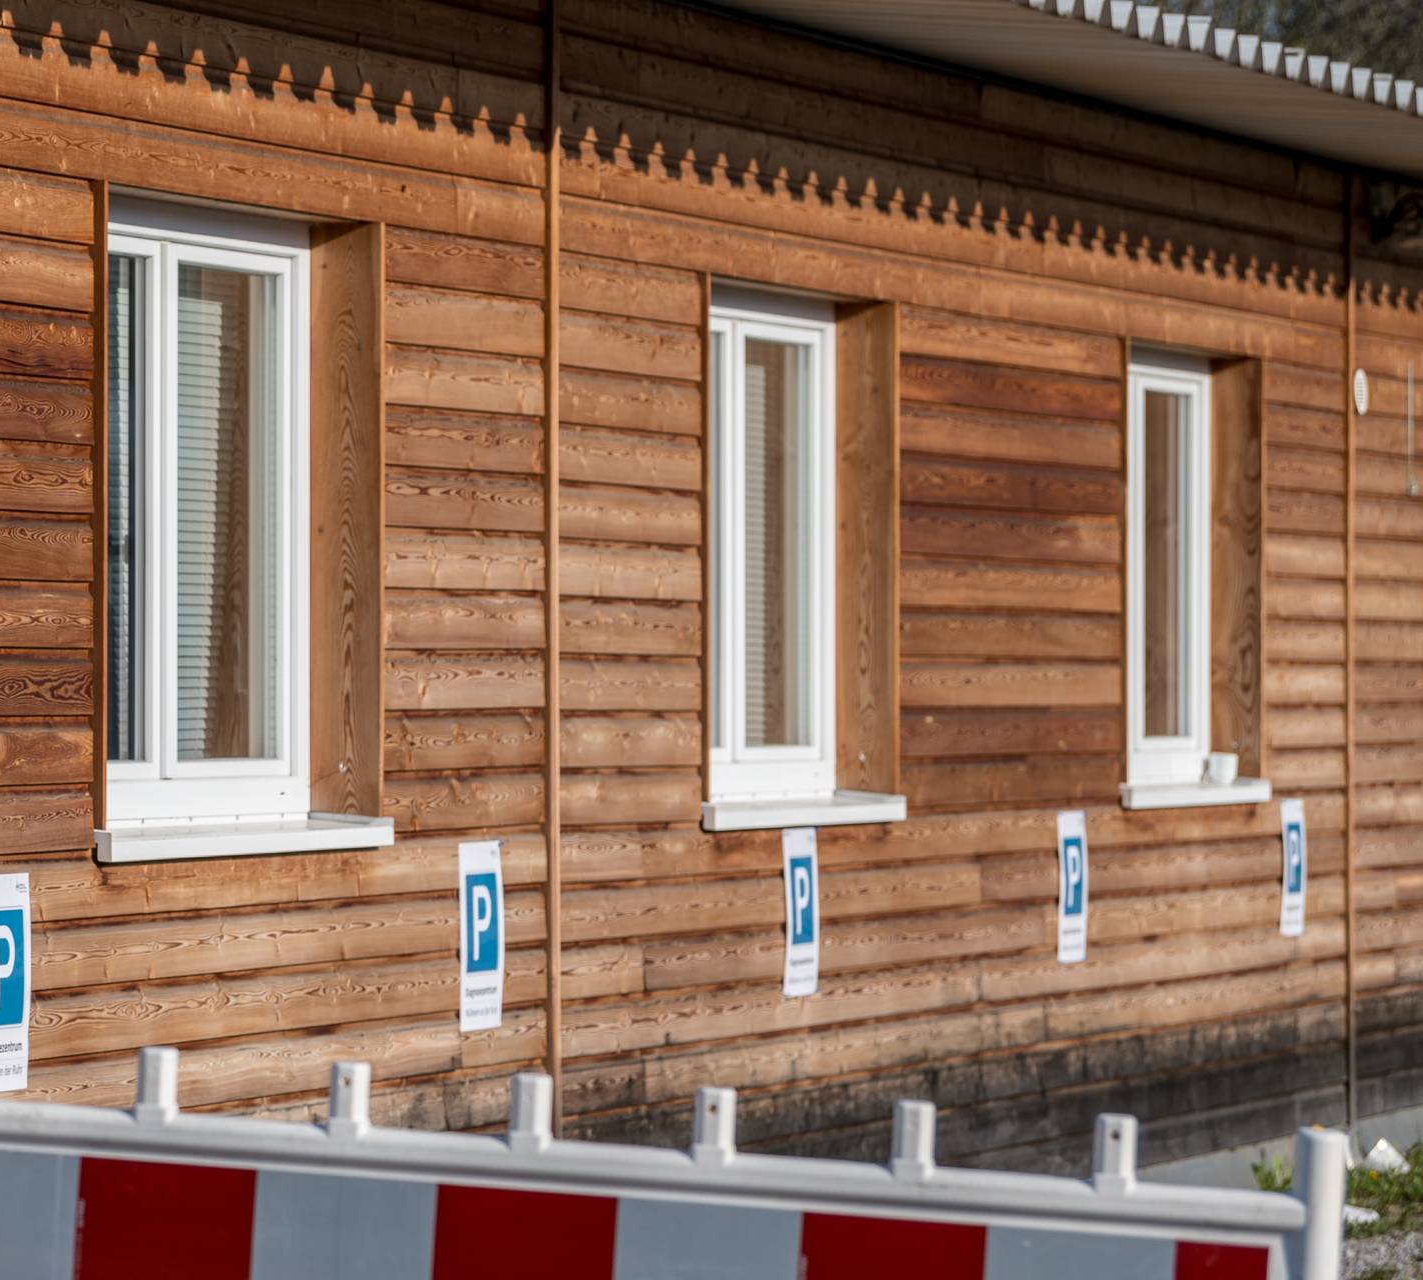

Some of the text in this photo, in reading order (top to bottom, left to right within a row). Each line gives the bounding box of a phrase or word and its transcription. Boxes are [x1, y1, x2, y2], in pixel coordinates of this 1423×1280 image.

[794, 866, 809, 936] P
[1066, 845, 1081, 908] P
[472, 884, 492, 961] P
